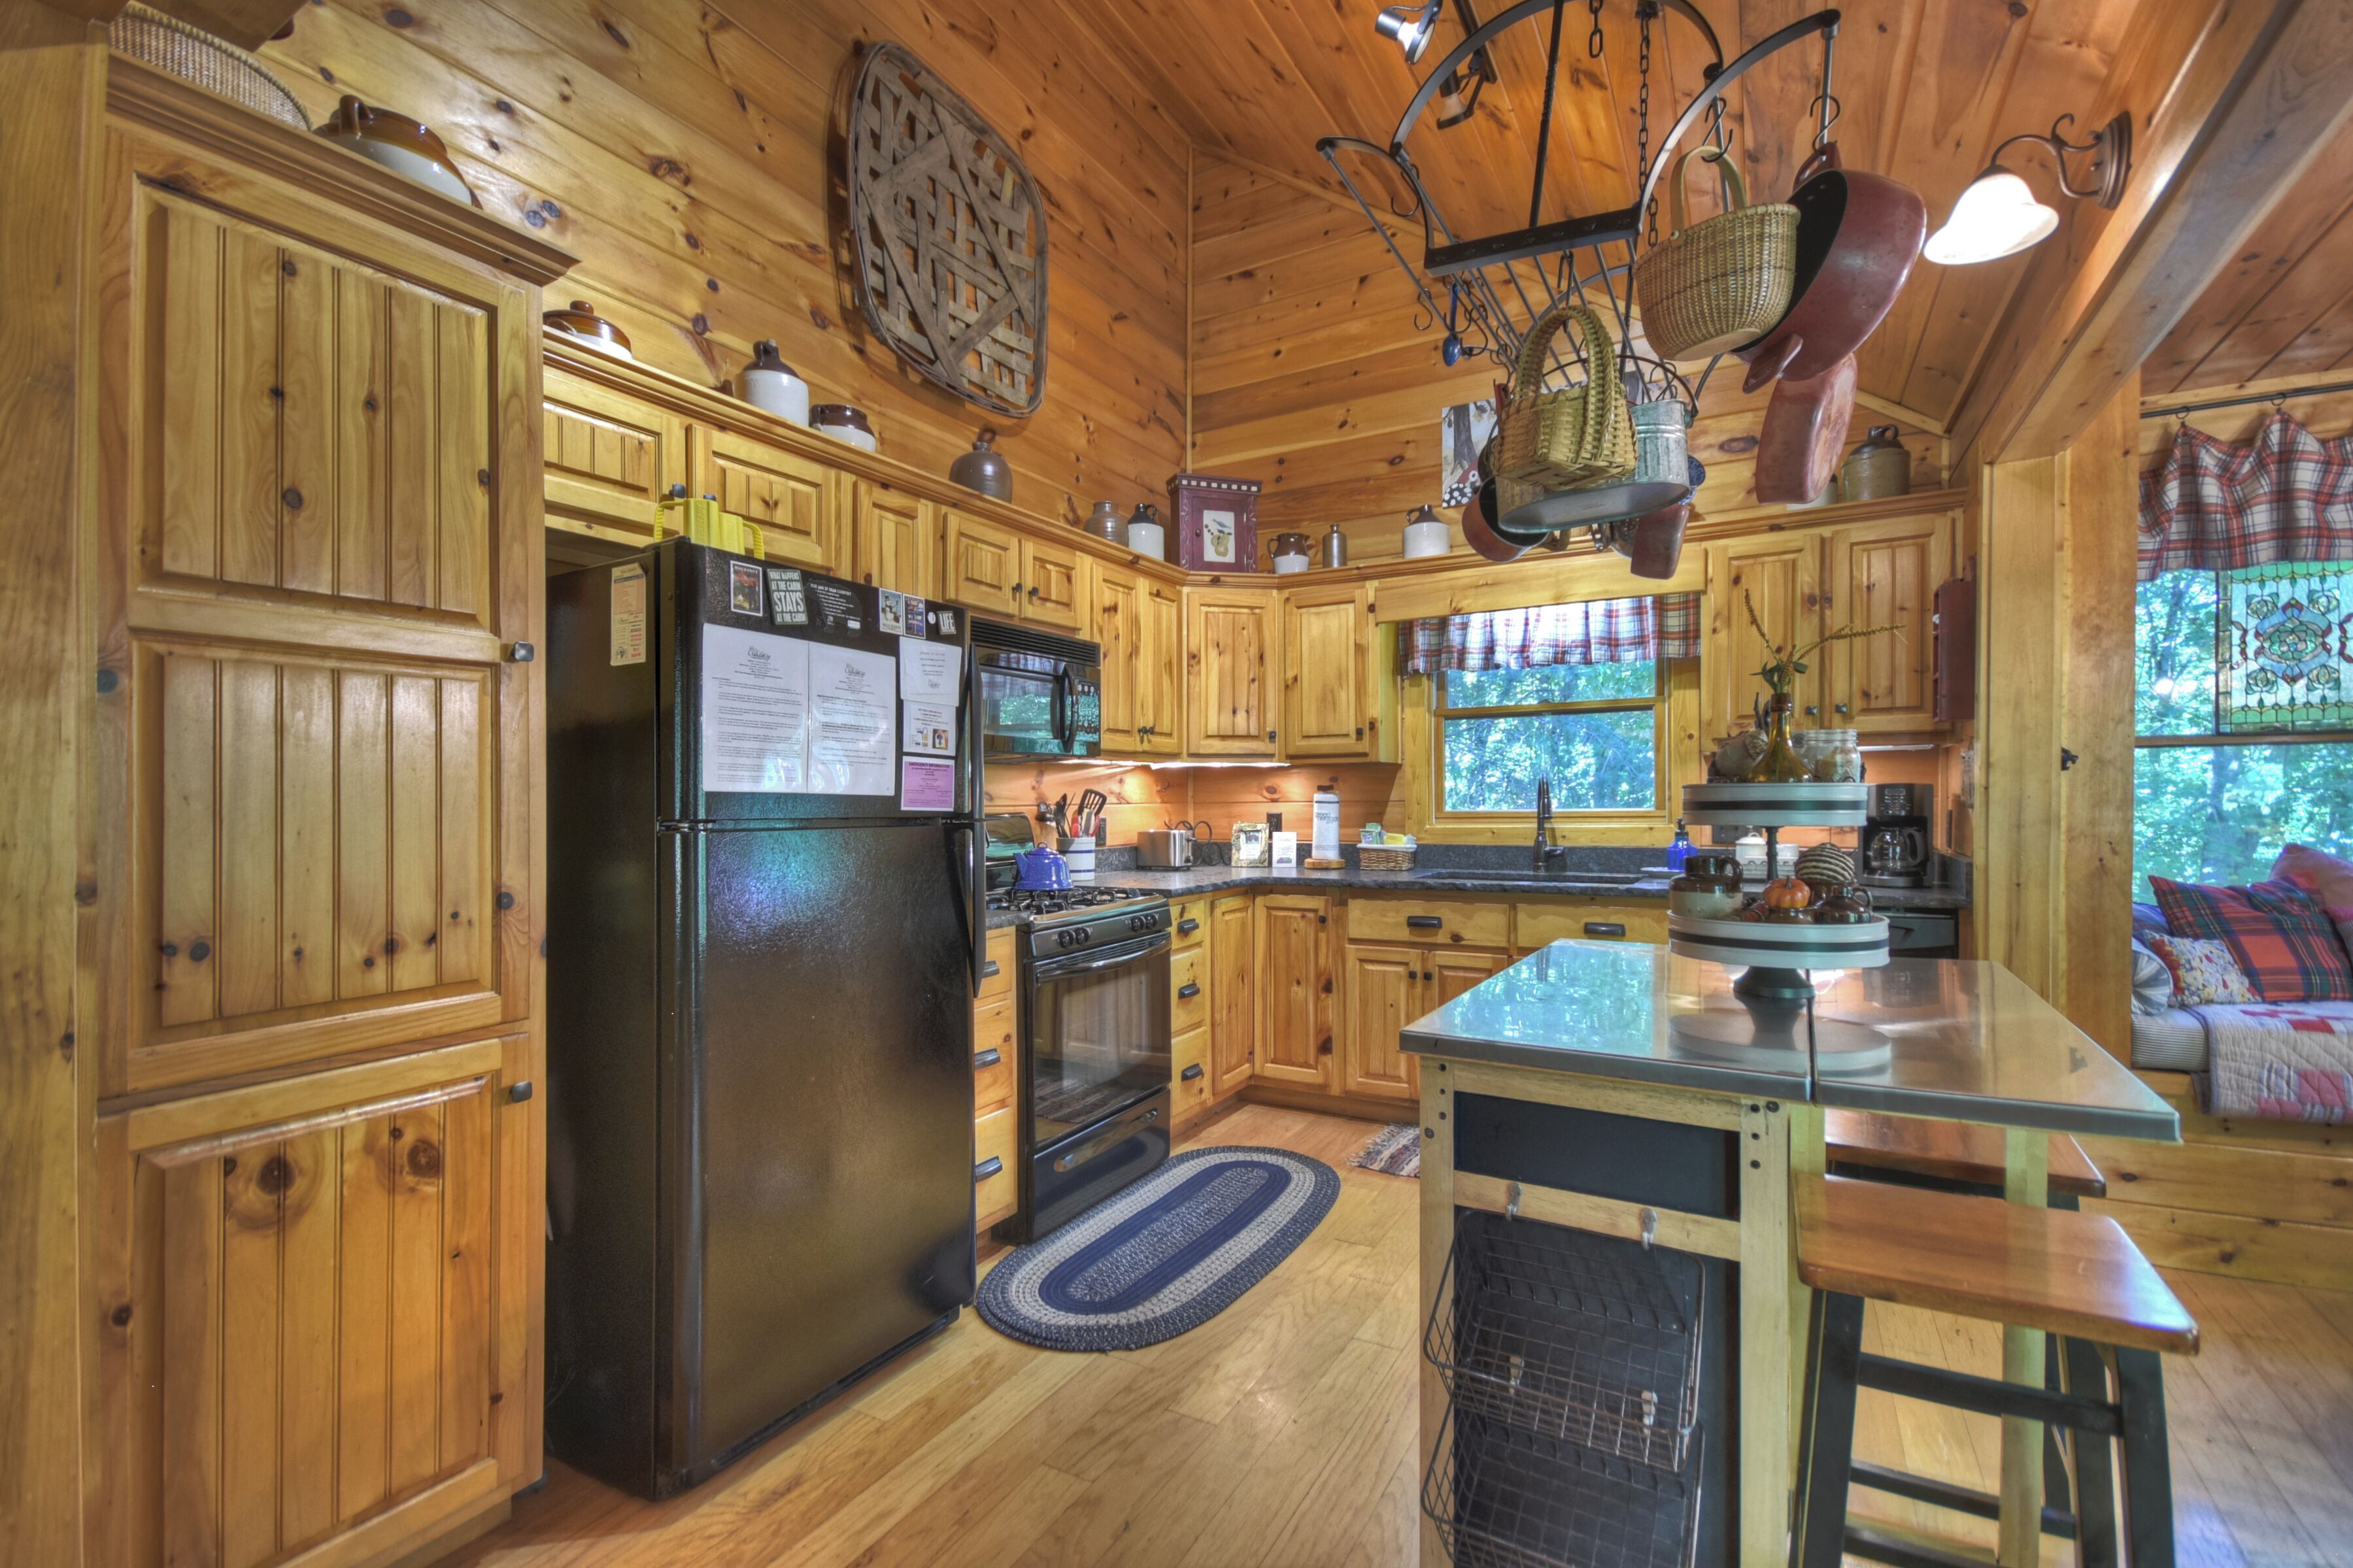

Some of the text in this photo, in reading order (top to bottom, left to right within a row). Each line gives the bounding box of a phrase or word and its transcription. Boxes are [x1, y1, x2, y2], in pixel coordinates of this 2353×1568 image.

[771, 580, 802, 591] AT THE CABIN
[773, 592, 804, 612] STAYS
[777, 613, 806, 622] AT THE CABIN
[939, 613, 955, 629] LIFE
